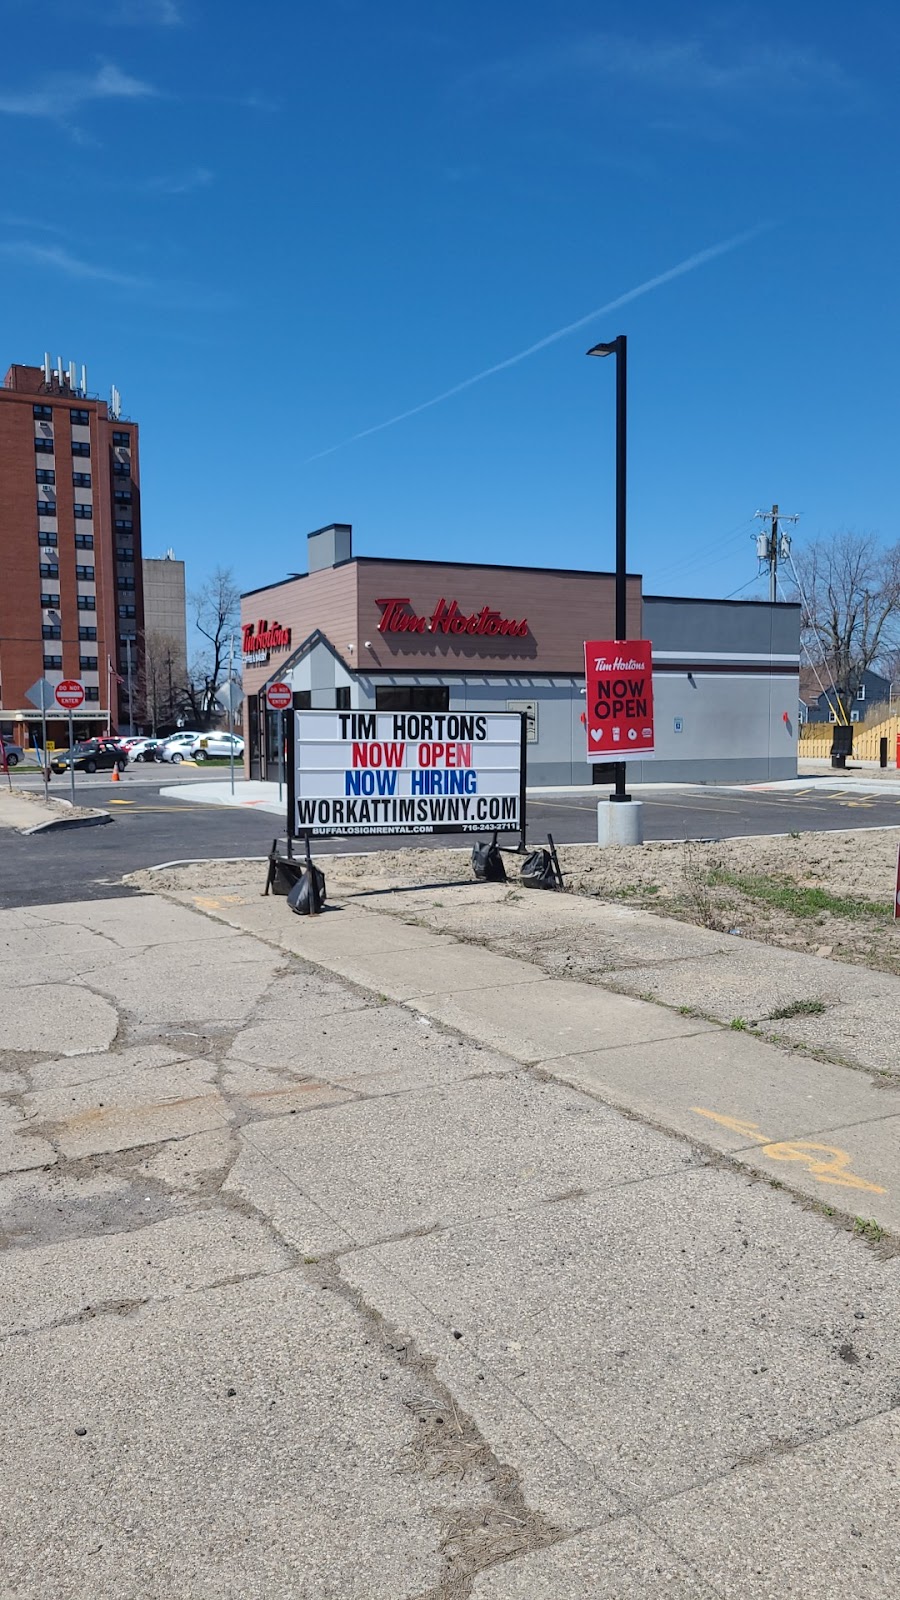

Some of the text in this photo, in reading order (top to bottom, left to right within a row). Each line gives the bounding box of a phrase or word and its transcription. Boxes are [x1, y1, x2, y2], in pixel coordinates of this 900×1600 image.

[375, 597, 528, 637] Tim Hortons
[242, 619, 289, 653] Tim Hortons
[594, 656, 645, 672] Tim Hortons
[597, 679, 645, 700] NOW
[594, 699, 647, 720] OPEN
[338, 714, 487, 741] TIM HORTONS
[352, 742, 471, 768] NOW OPEN
[345, 769, 477, 796] NOW HIRING
[297, 797, 517, 824] WORKATTIMSWNY.COM
[311, 823, 516, 835] BUFFALOSIGNRENTAL.COM 716-243-2711
